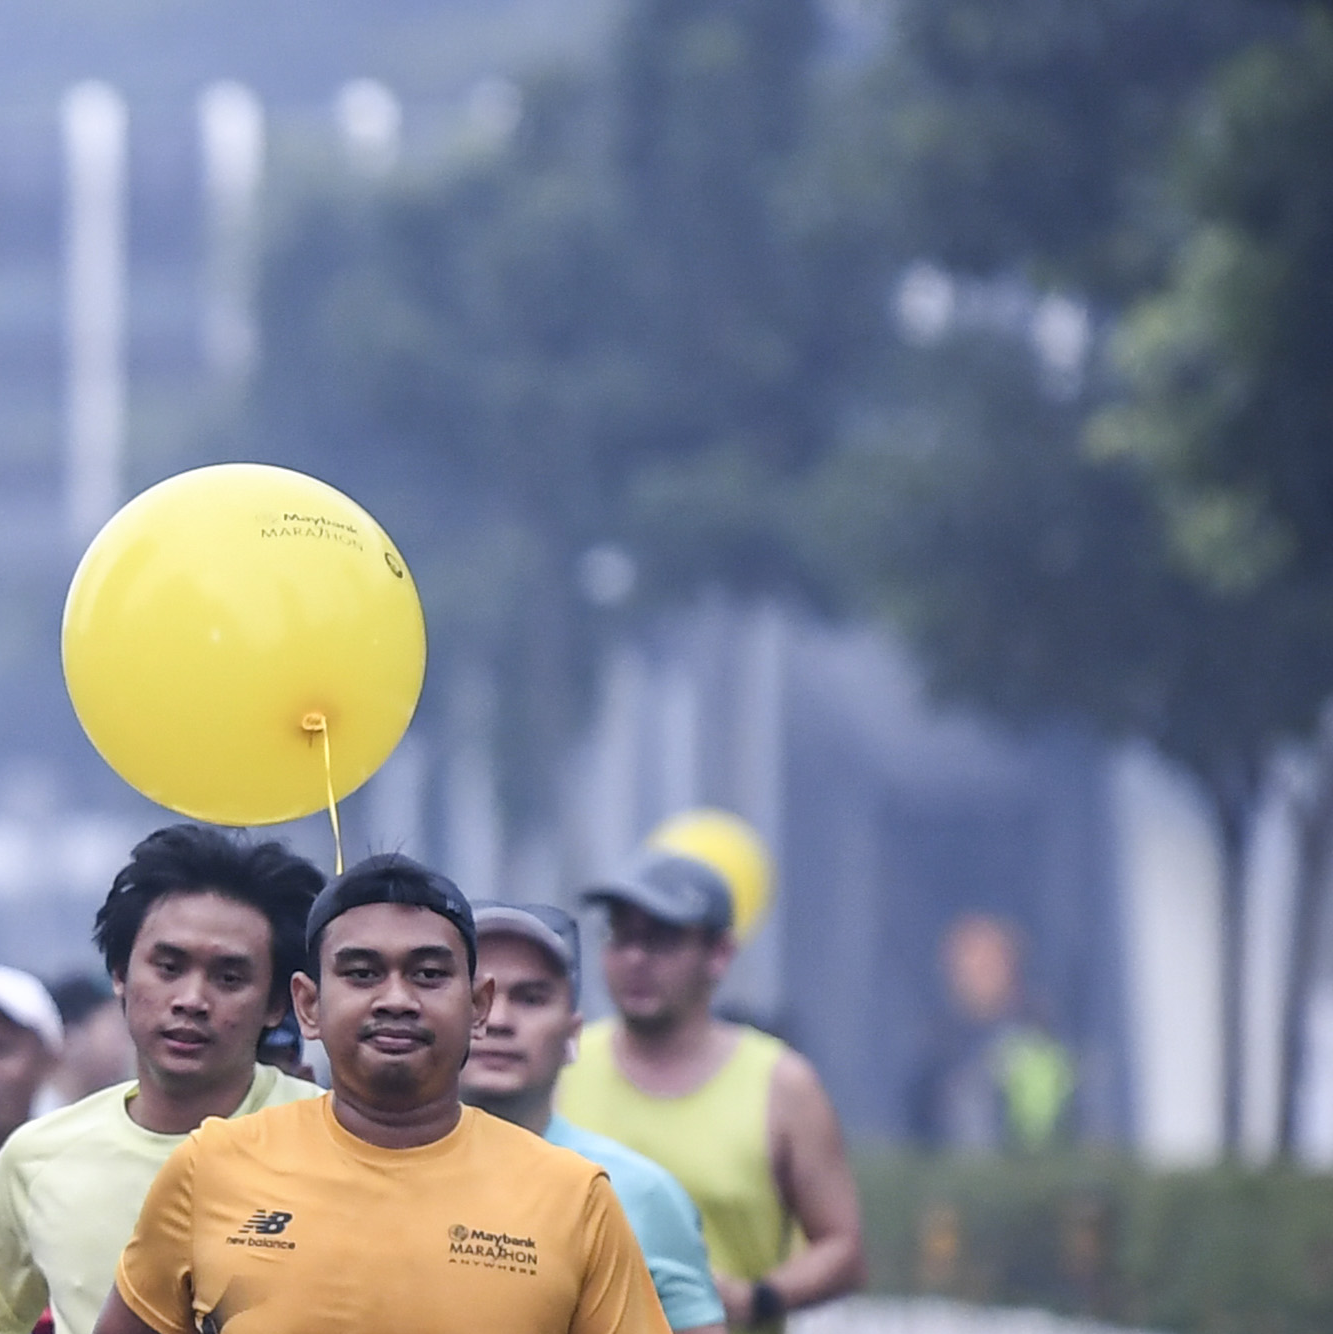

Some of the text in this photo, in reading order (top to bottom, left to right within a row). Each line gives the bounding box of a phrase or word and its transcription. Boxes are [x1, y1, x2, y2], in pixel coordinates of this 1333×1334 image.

[226, 1236, 296, 1250] new balance
[471, 1229, 537, 1250] Maybank
[449, 1242, 538, 1265] MARATHON
[448, 1258, 538, 1275] ANYWHERE
